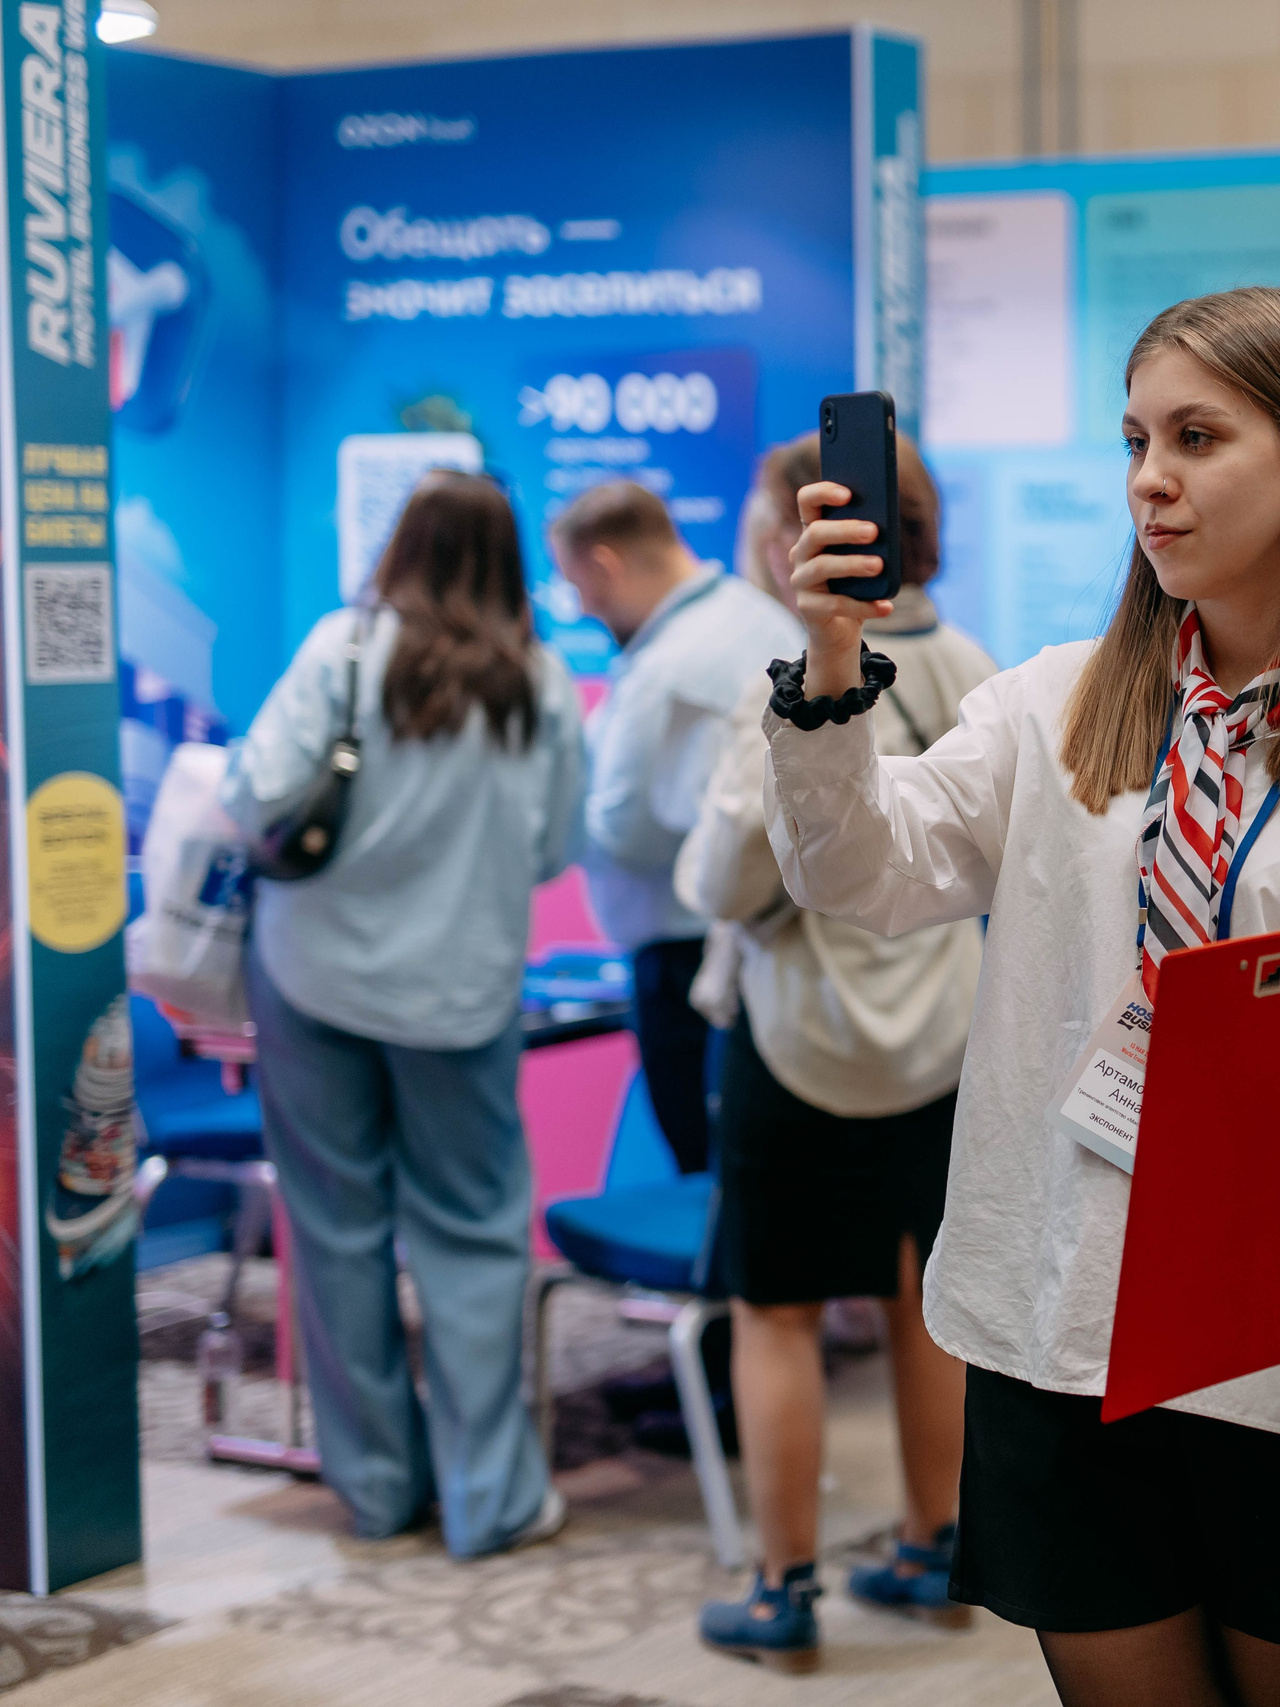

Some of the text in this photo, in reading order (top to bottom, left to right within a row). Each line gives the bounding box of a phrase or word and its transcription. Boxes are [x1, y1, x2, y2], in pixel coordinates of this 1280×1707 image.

[65, 51, 91, 243] BUSINESS
[19, 1, 71, 367] RUVIERA
[339, 206, 551, 261] Обещать
[345, 267, 762, 321] значит заселиться
[615, 371, 718, 433] 000
[1077, 1087, 1105, 1107] Тренинговое
[1105, 1104, 1127, 1120] агентство
[1094, 1060, 1145, 1095] Артамо
[1108, 1088, 1142, 1115] Анна
[1089, 1112, 1134, 1142] ЭКСПОНЕНТ
